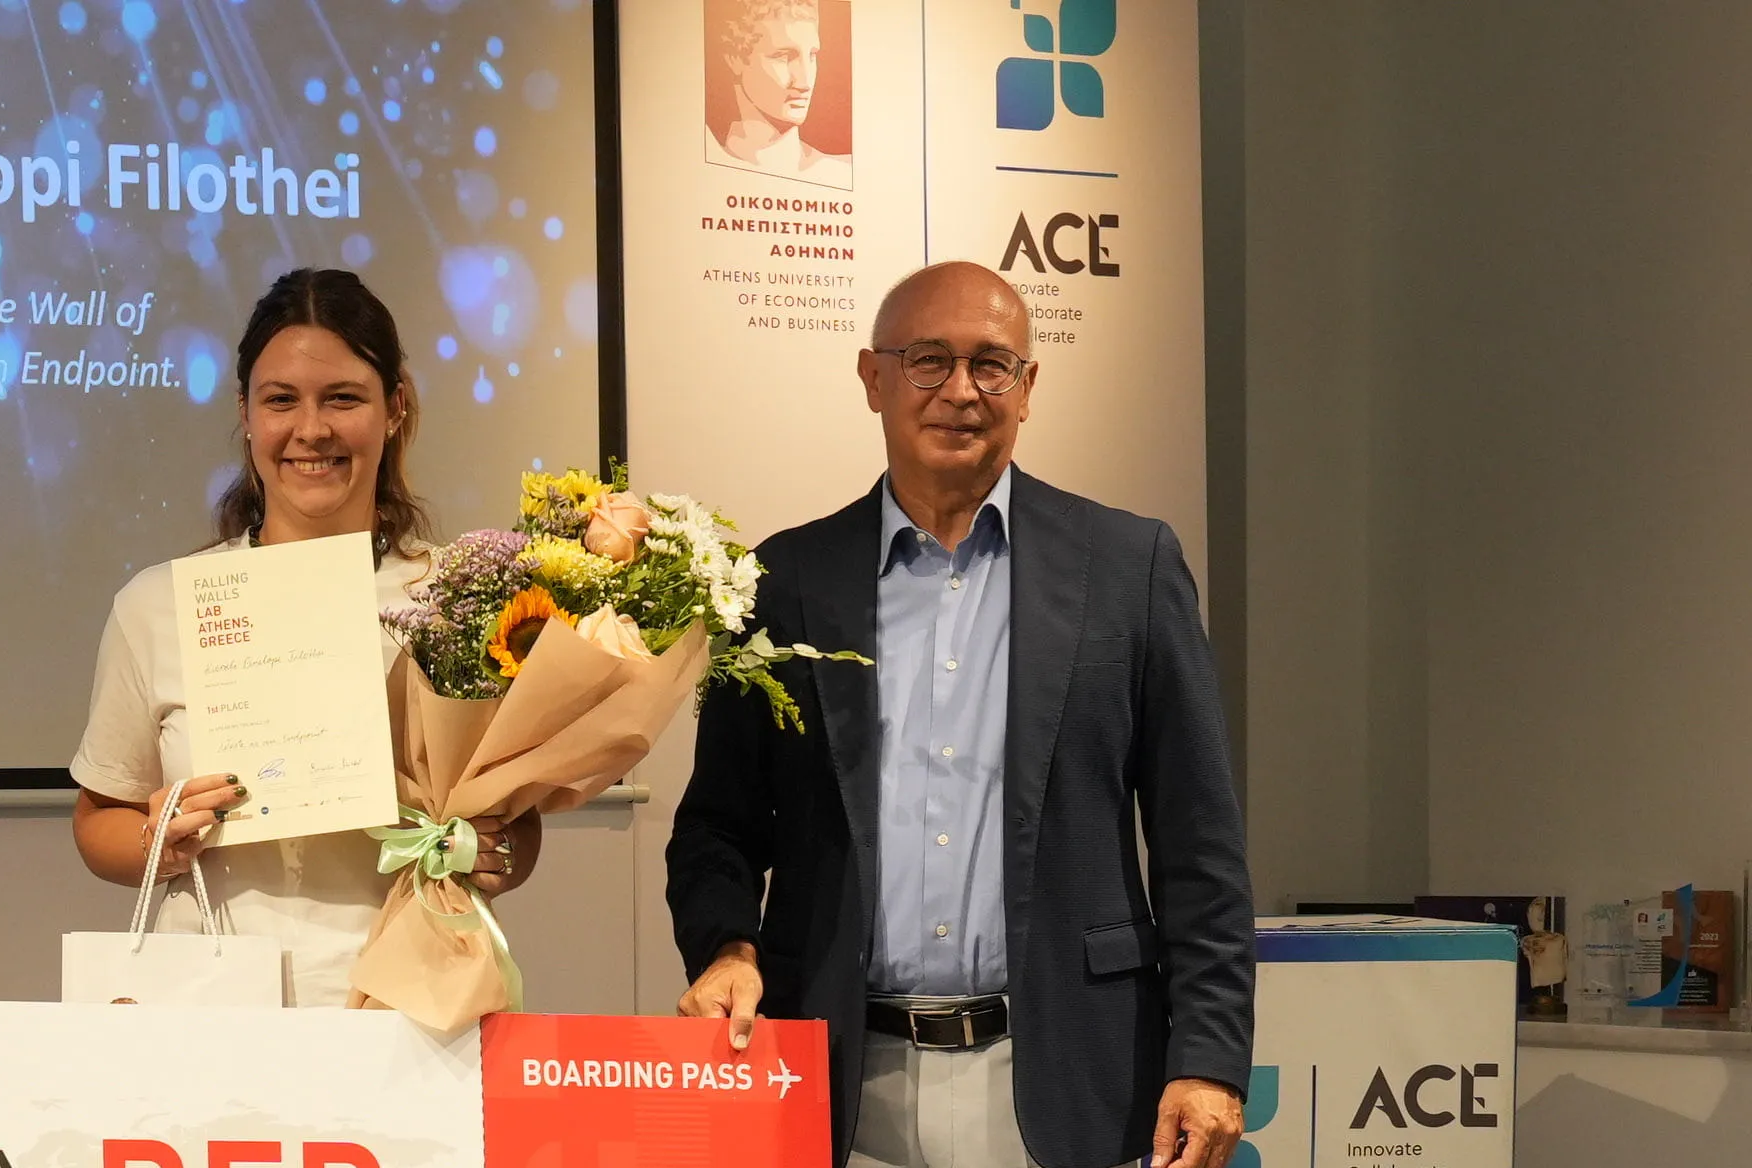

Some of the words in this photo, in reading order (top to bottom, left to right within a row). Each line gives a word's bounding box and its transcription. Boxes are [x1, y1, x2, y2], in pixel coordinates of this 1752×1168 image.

[107, 140, 360, 219] Filothei
[726, 195, 853, 215] ΟΙΚΟΝΟΜΙΚΟ
[701, 217, 854, 238] ΠΑΝΕΠΙΣΤΗΜΙΟ
[770, 244, 854, 261] ΑΘΗΝΩΝ
[998, 210, 1121, 277] ACE
[703, 269, 761, 284] ATHENS
[768, 272, 855, 288] UNIVERSITY
[738, 293, 758, 305] OF
[765, 294, 855, 310] ECONOMICS
[30, 290, 105, 327] Wall
[115, 291, 154, 335] of
[1028, 303, 1083, 321] aborate
[748, 316, 781, 329] AND
[788, 317, 855, 332] BUSINESS
[1033, 326, 1076, 343] lerate
[21, 350, 181, 393] Endpoint.
[194, 572, 249, 590] FALLING
[195, 588, 240, 604] WALLS
[197, 605, 222, 619] LAB
[198, 616, 254, 634] ATHENS,
[199, 631, 251, 648] GREECE
[220, 700, 250, 713] PLACE
[522, 1059, 674, 1088] BOARDING
[681, 1062, 753, 1090] PASS
[1349, 1063, 1499, 1129] ACE
[1347, 1142, 1423, 1157] Innovate
